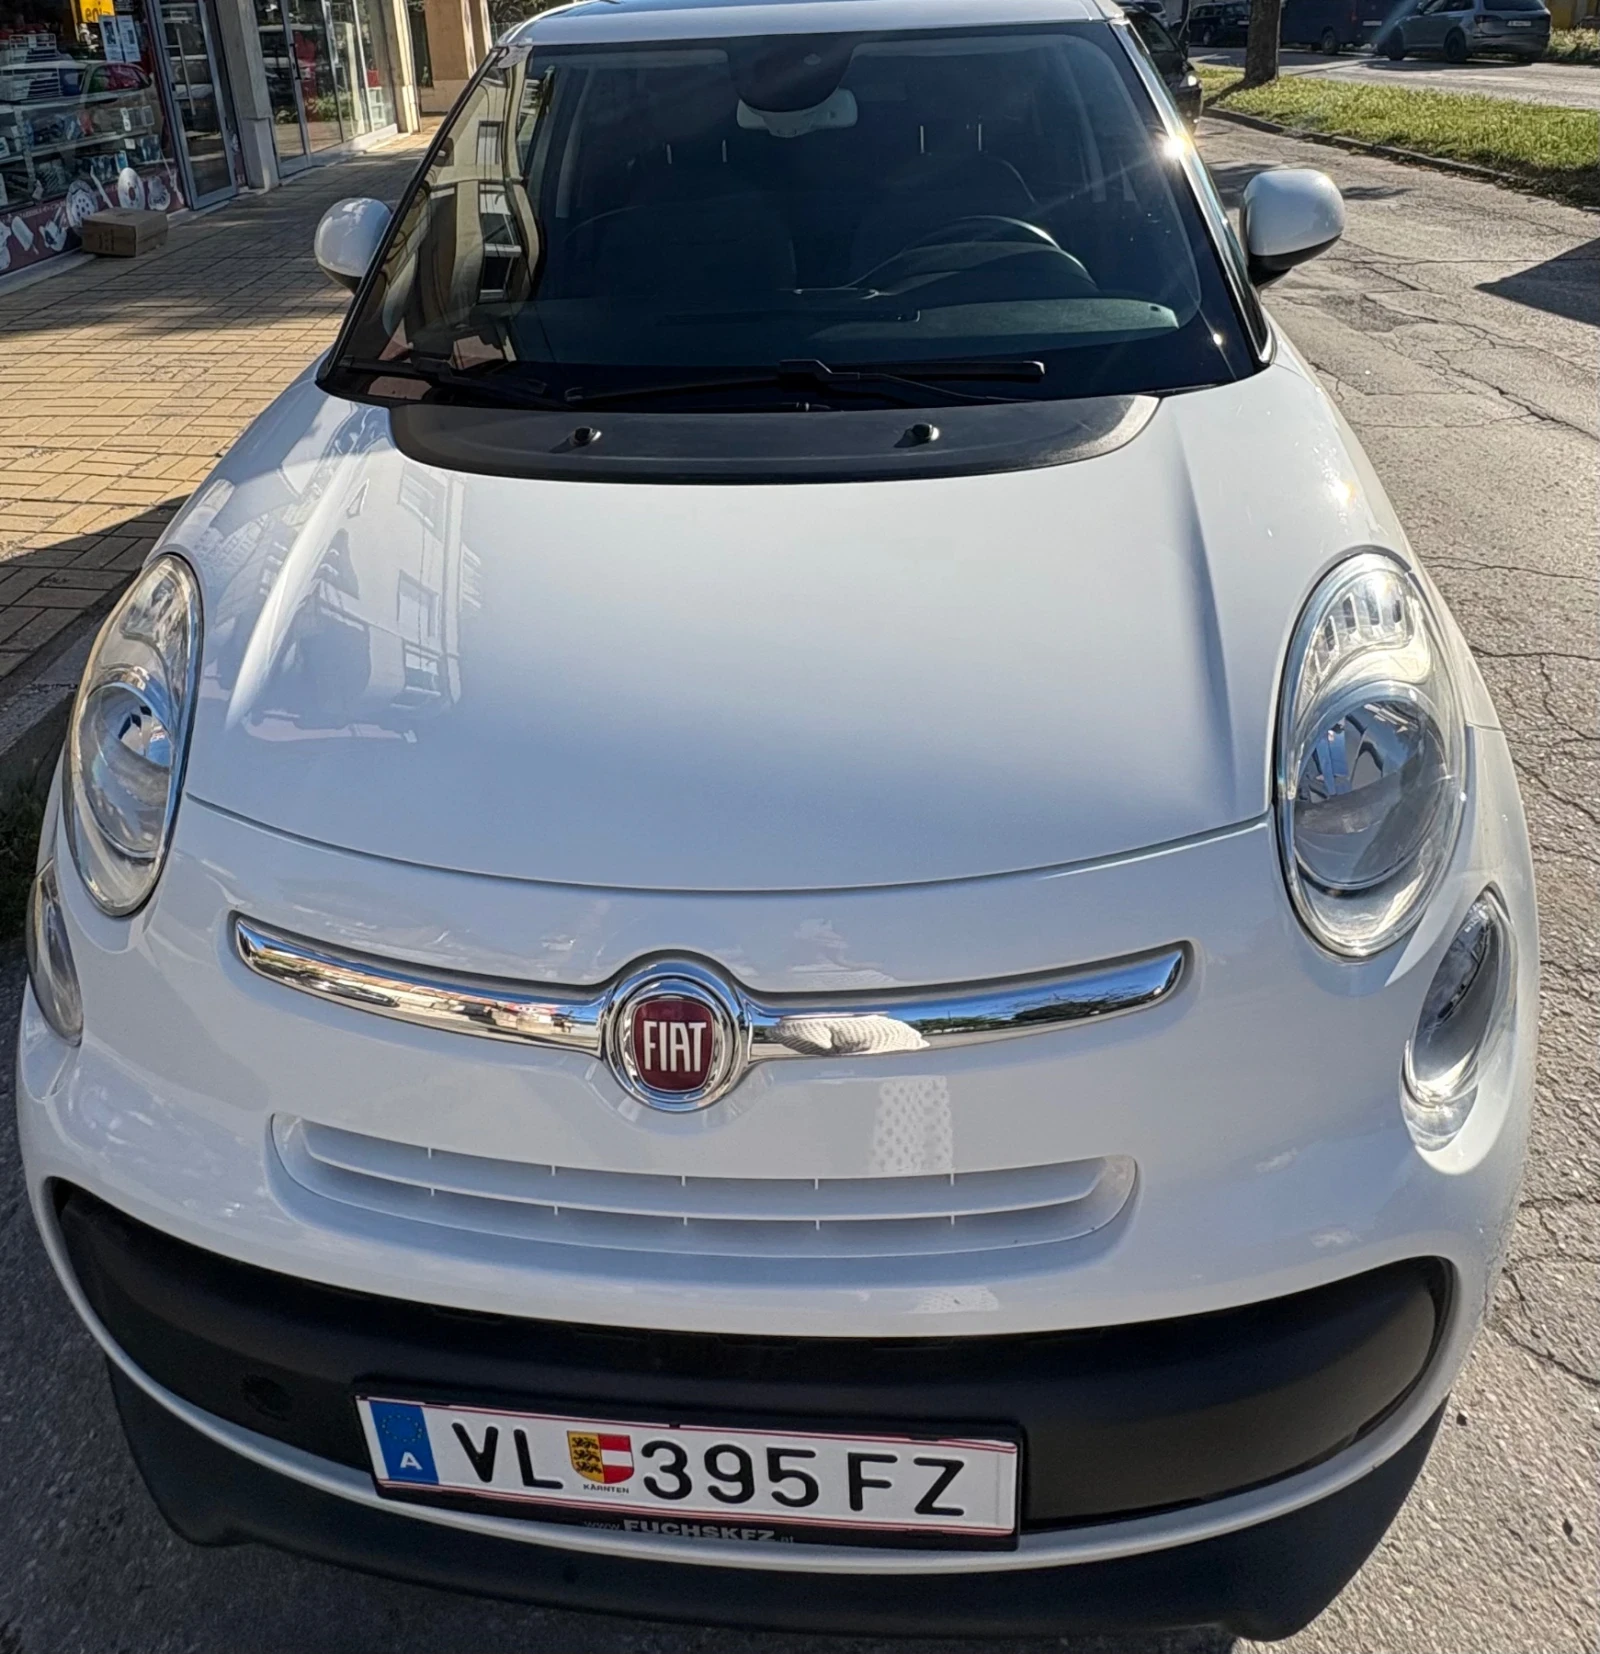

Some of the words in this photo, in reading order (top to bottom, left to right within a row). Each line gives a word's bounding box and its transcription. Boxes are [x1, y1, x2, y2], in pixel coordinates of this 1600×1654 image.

[643, 1020, 707, 1072] FIAT
[400, 1451, 423, 1471] A
[452, 1422, 564, 1490] VL
[641, 1440, 819, 1508] 395
[847, 1451, 965, 1517] FZ
